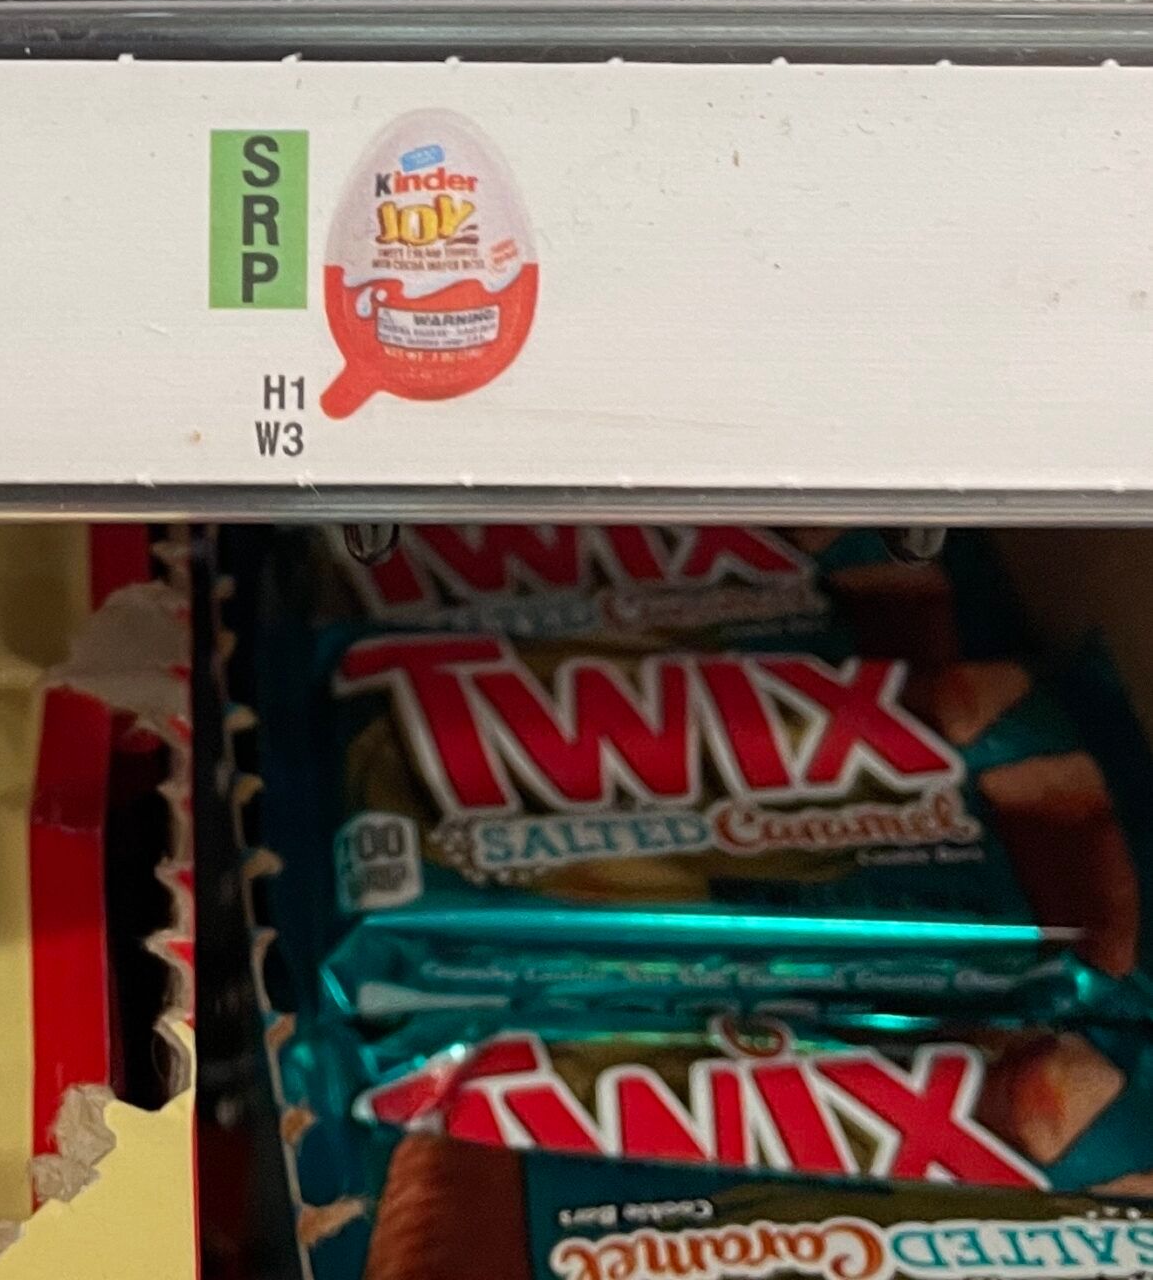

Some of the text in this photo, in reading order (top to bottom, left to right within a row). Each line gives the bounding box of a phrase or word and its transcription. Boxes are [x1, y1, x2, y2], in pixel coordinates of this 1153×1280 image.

[375, 194, 476, 246] JOY
[263, 375, 305, 411] H1
[255, 421, 304, 458] W3
[335, 635, 964, 811] TWIX
[480, 820, 710, 865] SALTED
